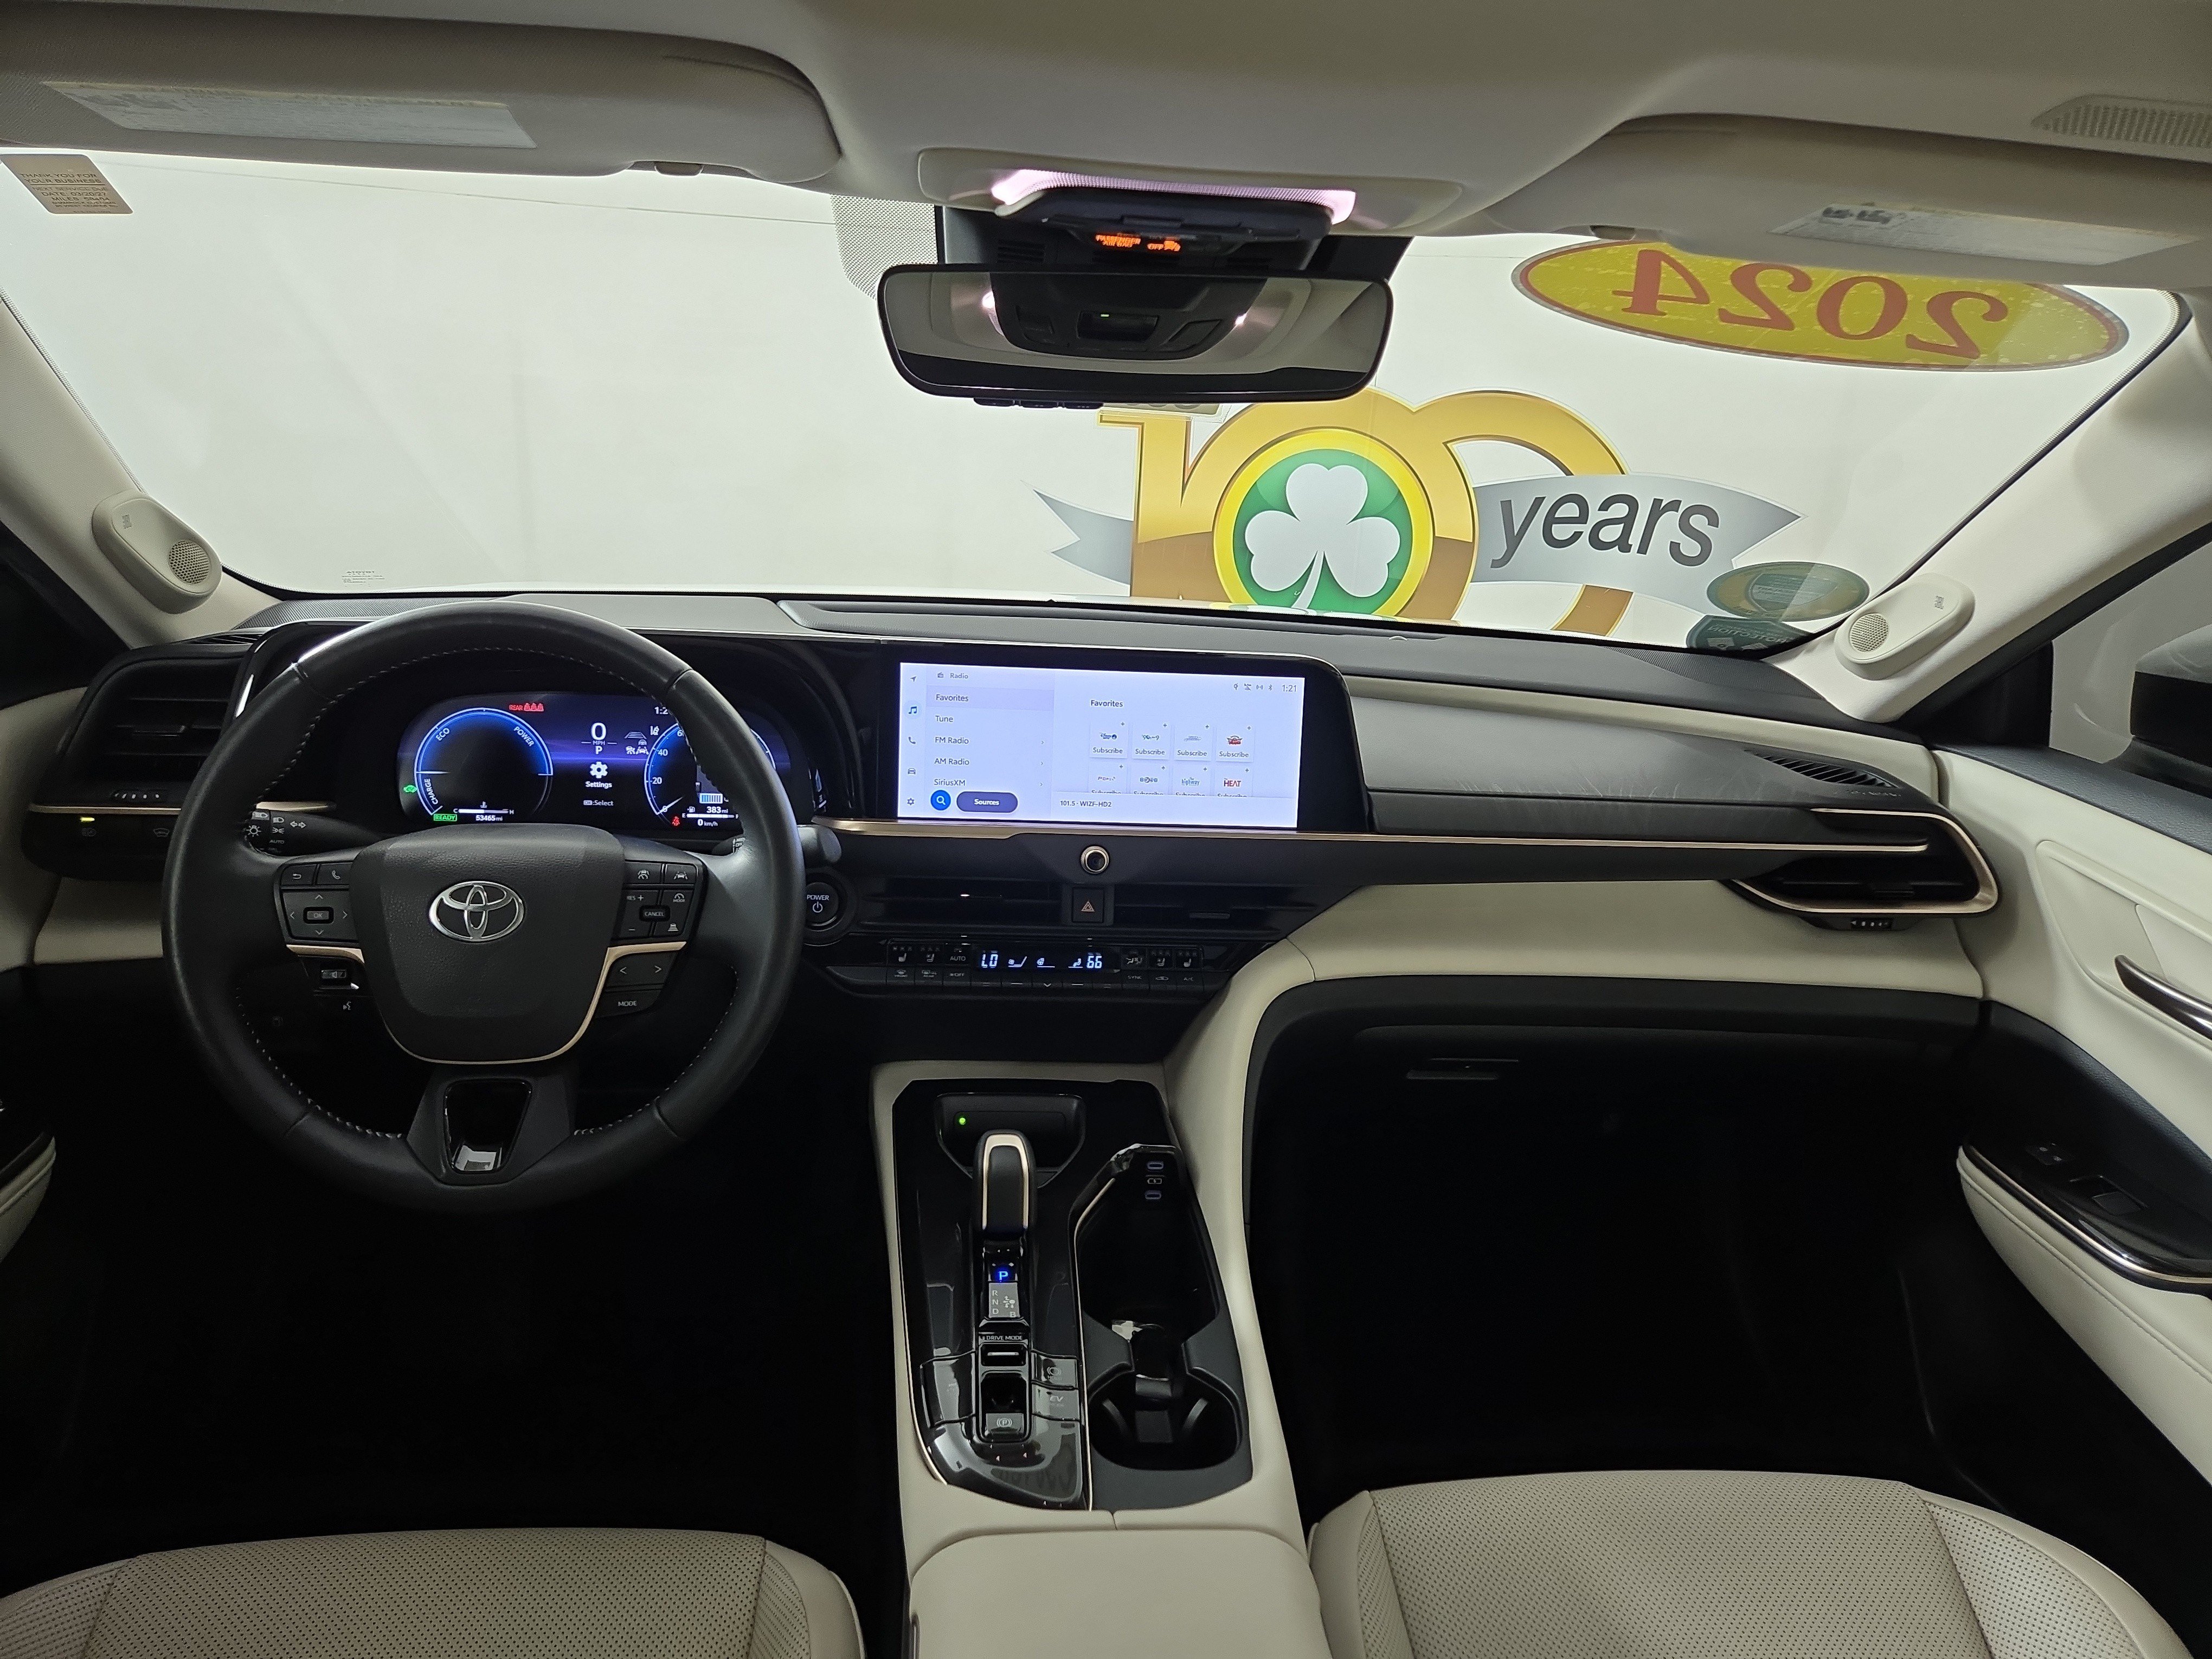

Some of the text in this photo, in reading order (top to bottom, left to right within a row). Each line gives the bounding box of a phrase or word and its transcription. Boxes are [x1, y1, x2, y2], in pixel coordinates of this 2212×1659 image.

[1491, 492, 1721, 569] years
[436, 728, 450, 741] ECO
[514, 726, 535, 747] POWER
[591, 723, 606, 740] 0
[595, 746, 603, 754] P
[424, 778, 439, 805] CHARGE
[1086, 955, 1103, 969] 66
[999, 1271, 1008, 1281] P
